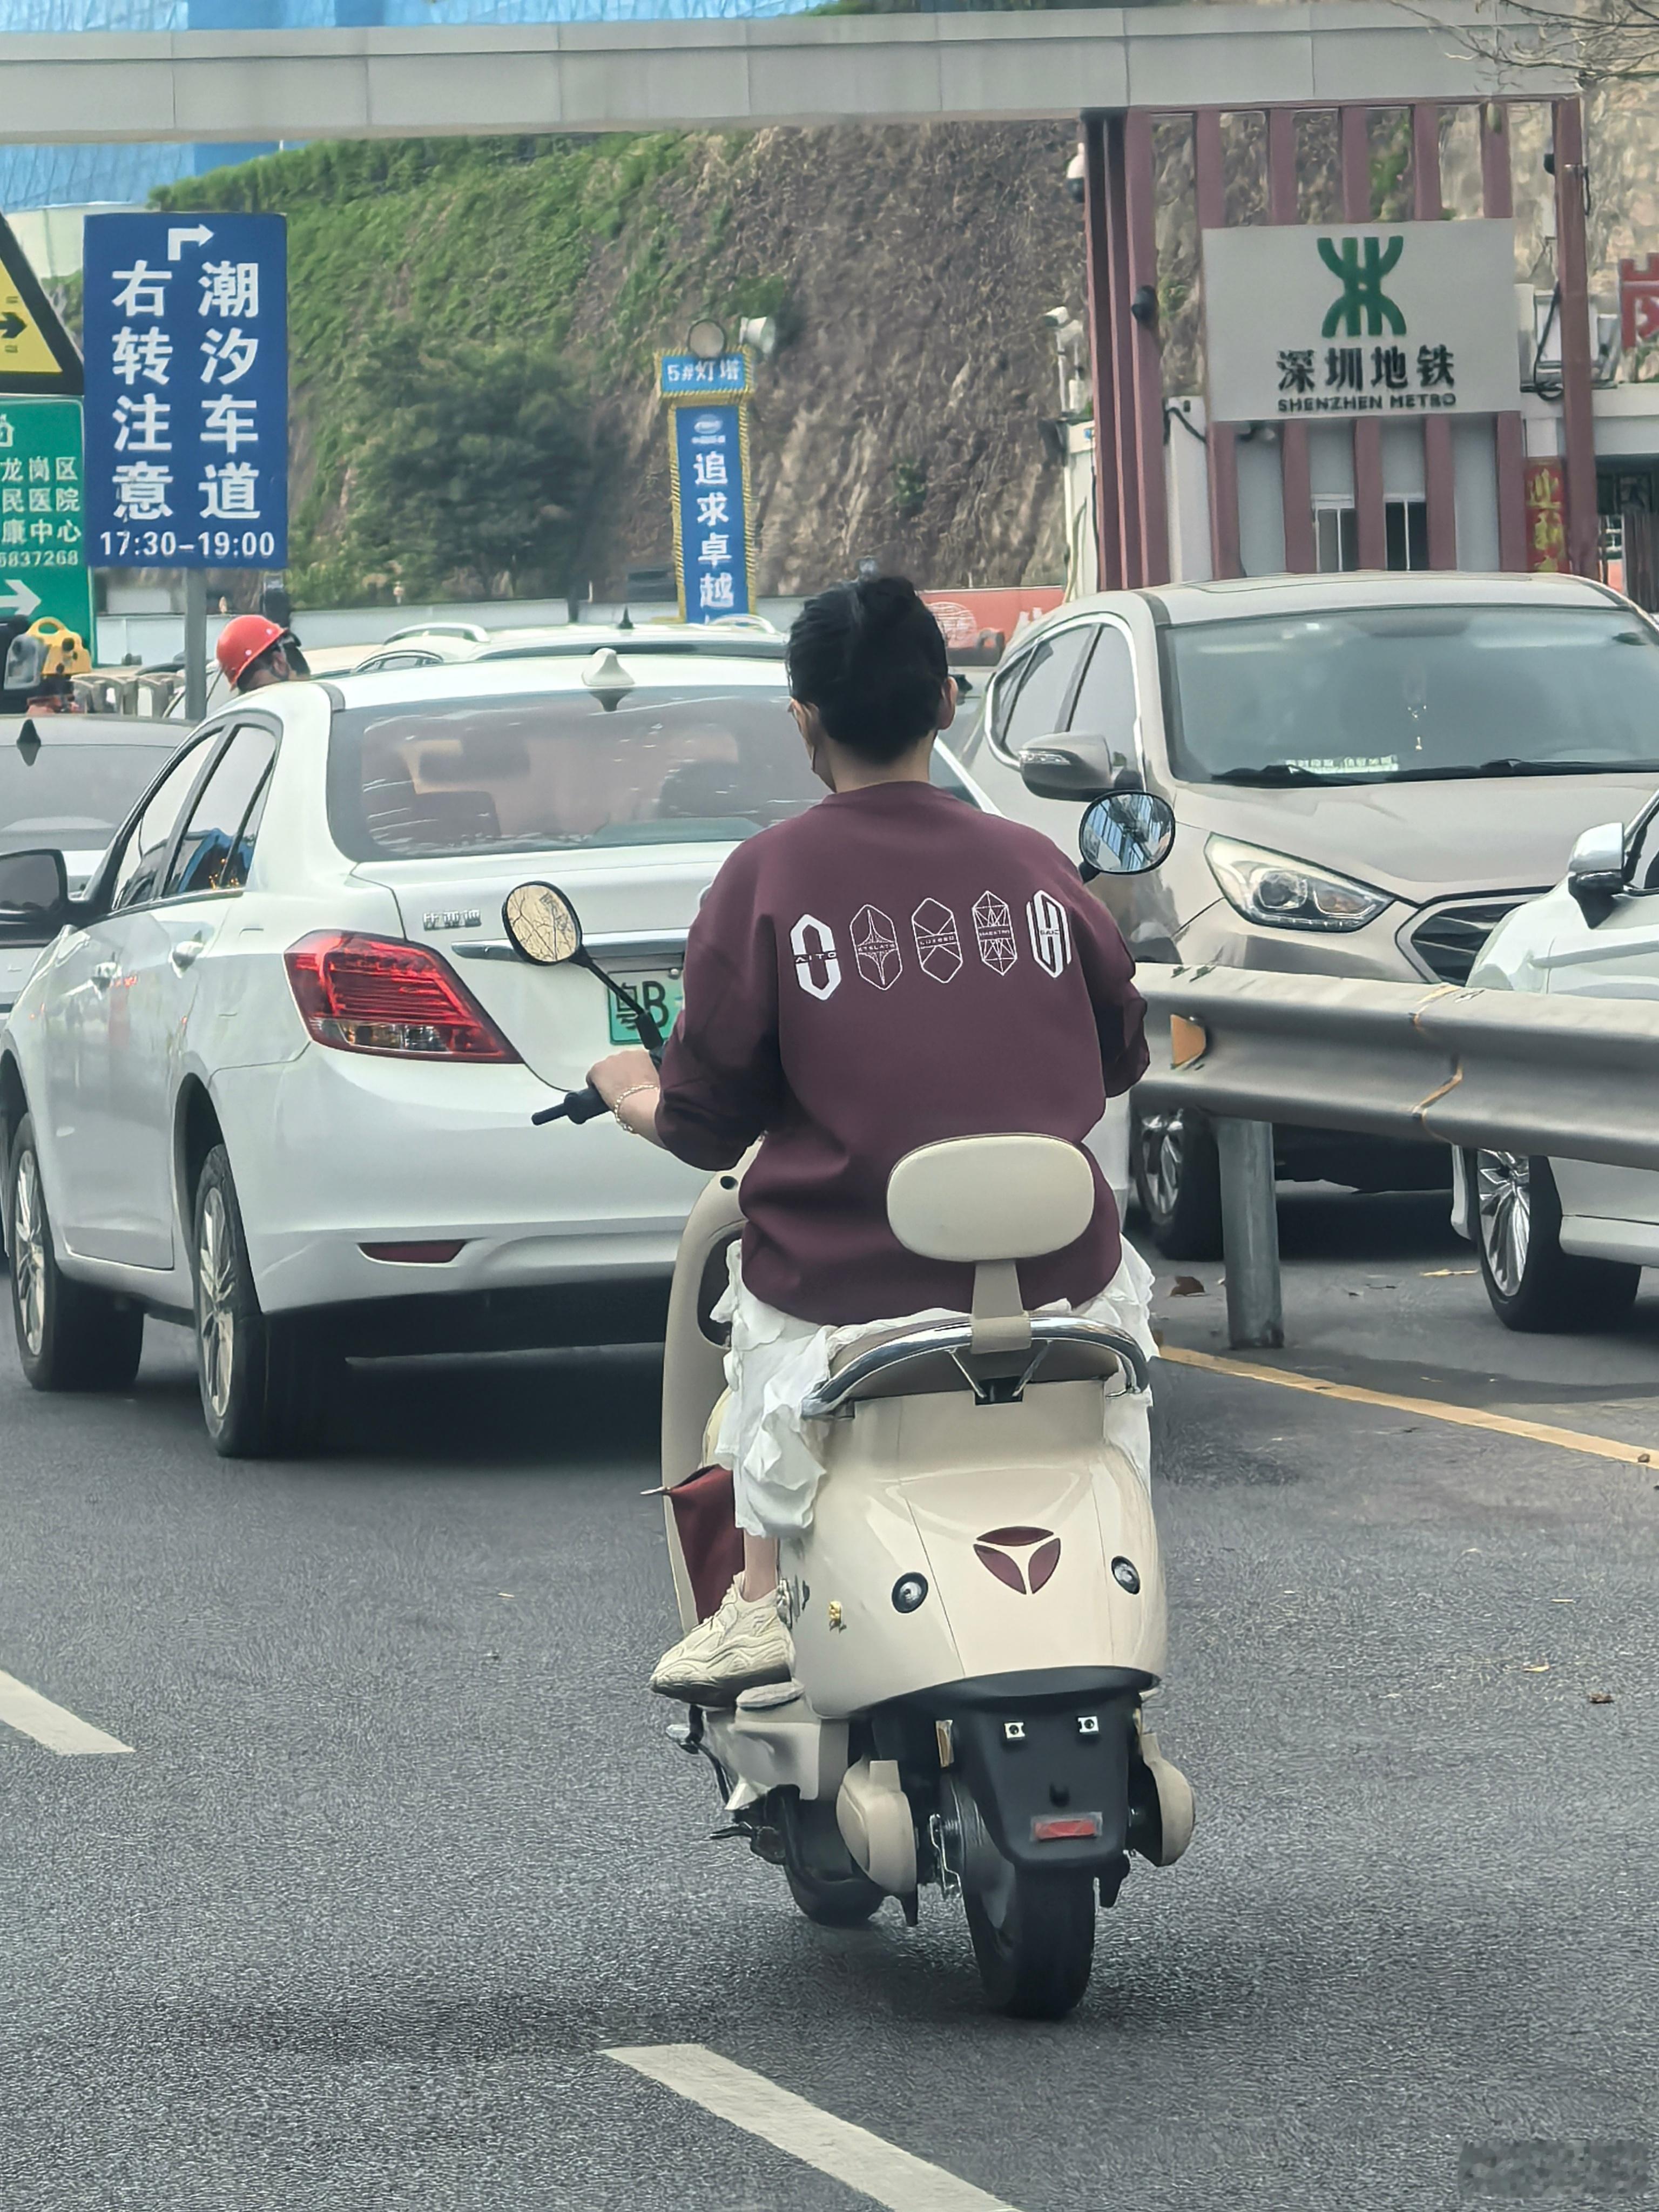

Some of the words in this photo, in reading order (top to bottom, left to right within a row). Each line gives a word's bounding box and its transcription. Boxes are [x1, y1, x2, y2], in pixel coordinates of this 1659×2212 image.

[112, 259, 173, 520] 右转注意
[198, 260, 261, 520] 潮汐车道
[1277, 344, 1455, 393] 深圳地铁
[1278, 395, 1383, 413] SHENZHEN
[1390, 393, 1457, 409] METRO
[100, 531, 275, 556] 17:30-19:00
[693, 450, 735, 625] 追求卓越
[795, 952, 837, 963] AITO
